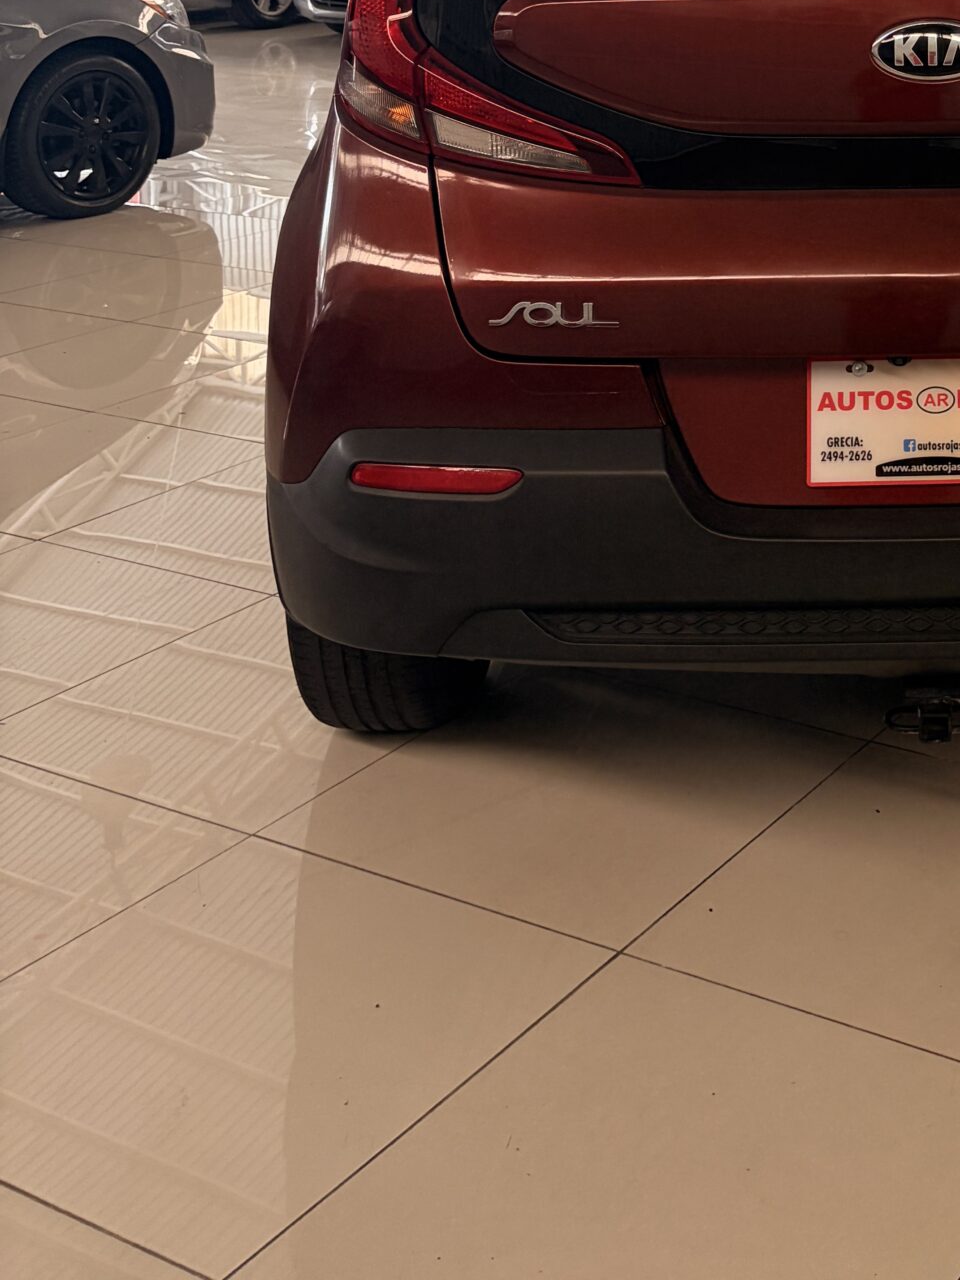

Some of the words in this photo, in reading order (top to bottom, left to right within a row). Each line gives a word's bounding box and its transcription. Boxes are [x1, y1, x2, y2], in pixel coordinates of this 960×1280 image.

[488, 301, 620, 328] SOUL
[817, 390, 914, 412] AUTOS
[923, 393, 949, 407] AR
[826, 436, 864, 448] GRECIA:
[820, 450, 873, 462] 2494-2626
